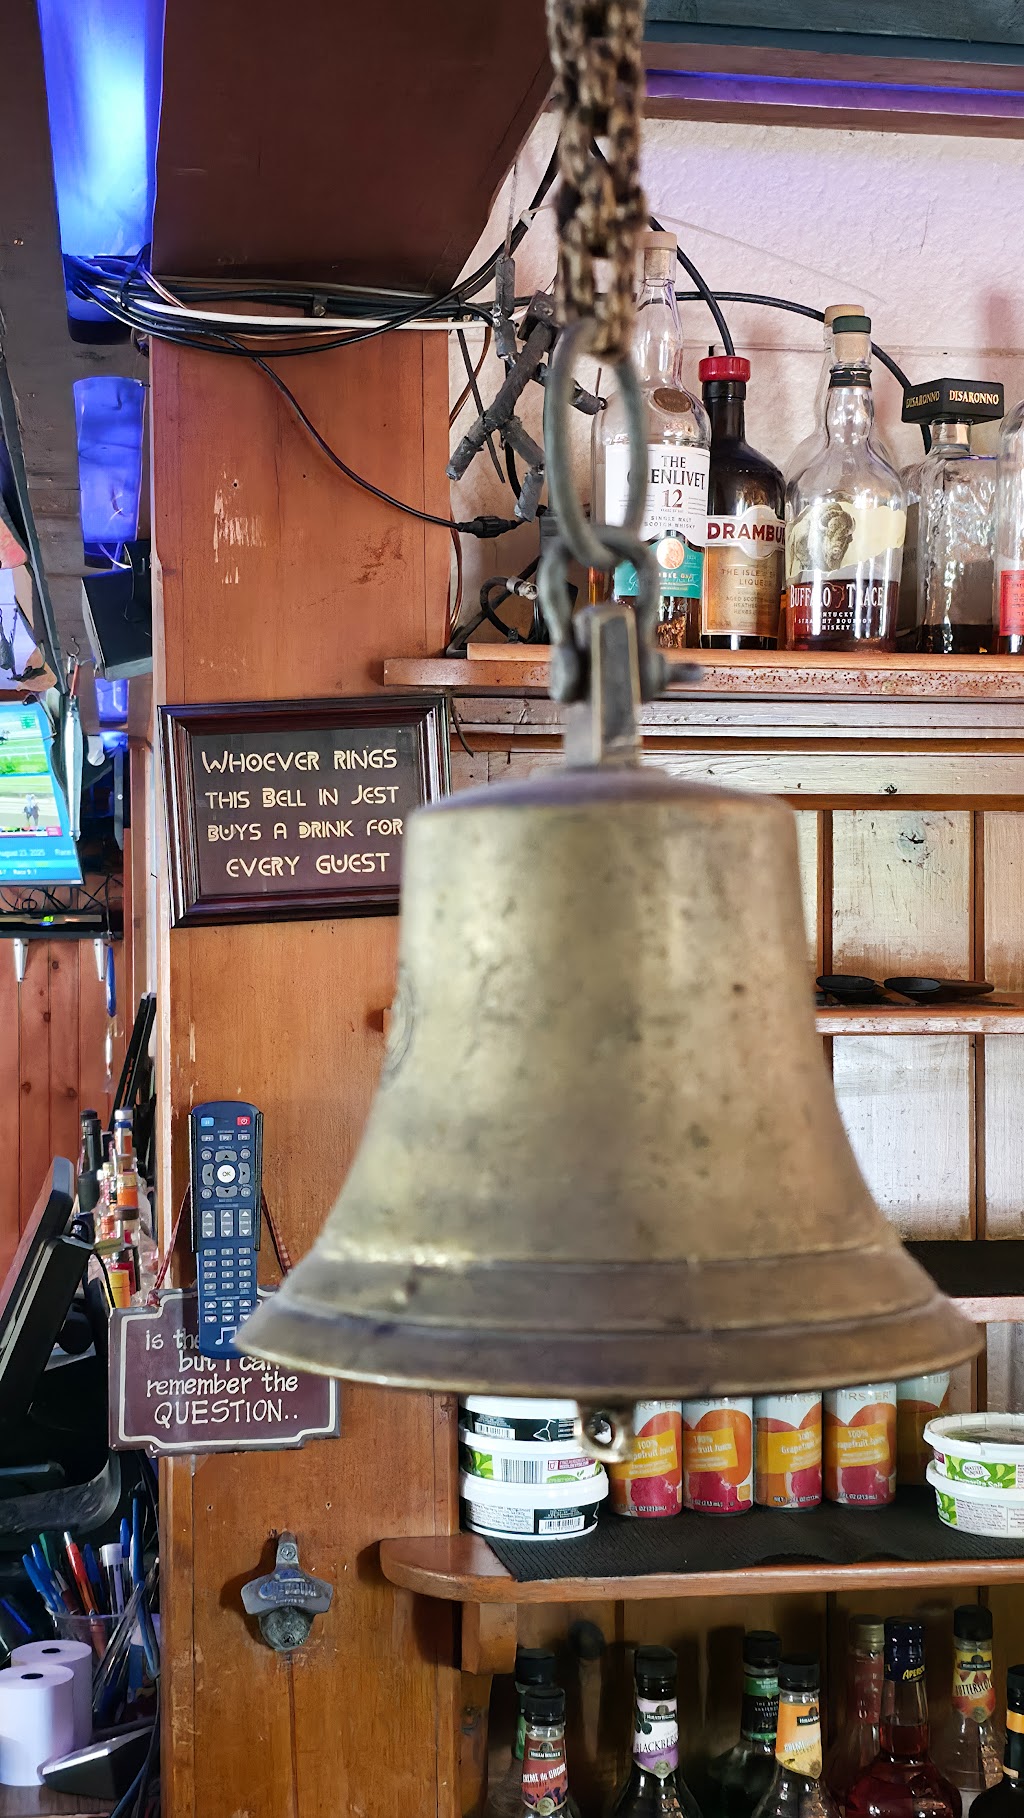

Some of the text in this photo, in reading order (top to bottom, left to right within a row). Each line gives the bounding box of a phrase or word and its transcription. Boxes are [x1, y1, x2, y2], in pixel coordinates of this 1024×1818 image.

[905, 390, 940, 409] DISARONNO
[949, 390, 1000, 405] DISARONNO
[661, 455, 686, 469] THE
[627, 469, 706, 490] ENLIVET
[661, 489, 684, 508] 12
[790, 585, 831, 608] BUFFO
[201, 748, 398, 773] WHOEVER RINGS
[204, 790, 250, 809] THIS
[318, 788, 338, 806] IN
[350, 784, 400, 805] JEST
[207, 818, 404, 842] BUYS A DRINK FOR
[226, 852, 391, 878] EVERY GUEST
[145, 1330, 164, 1350] is
[146, 1371, 299, 1397] remember the
